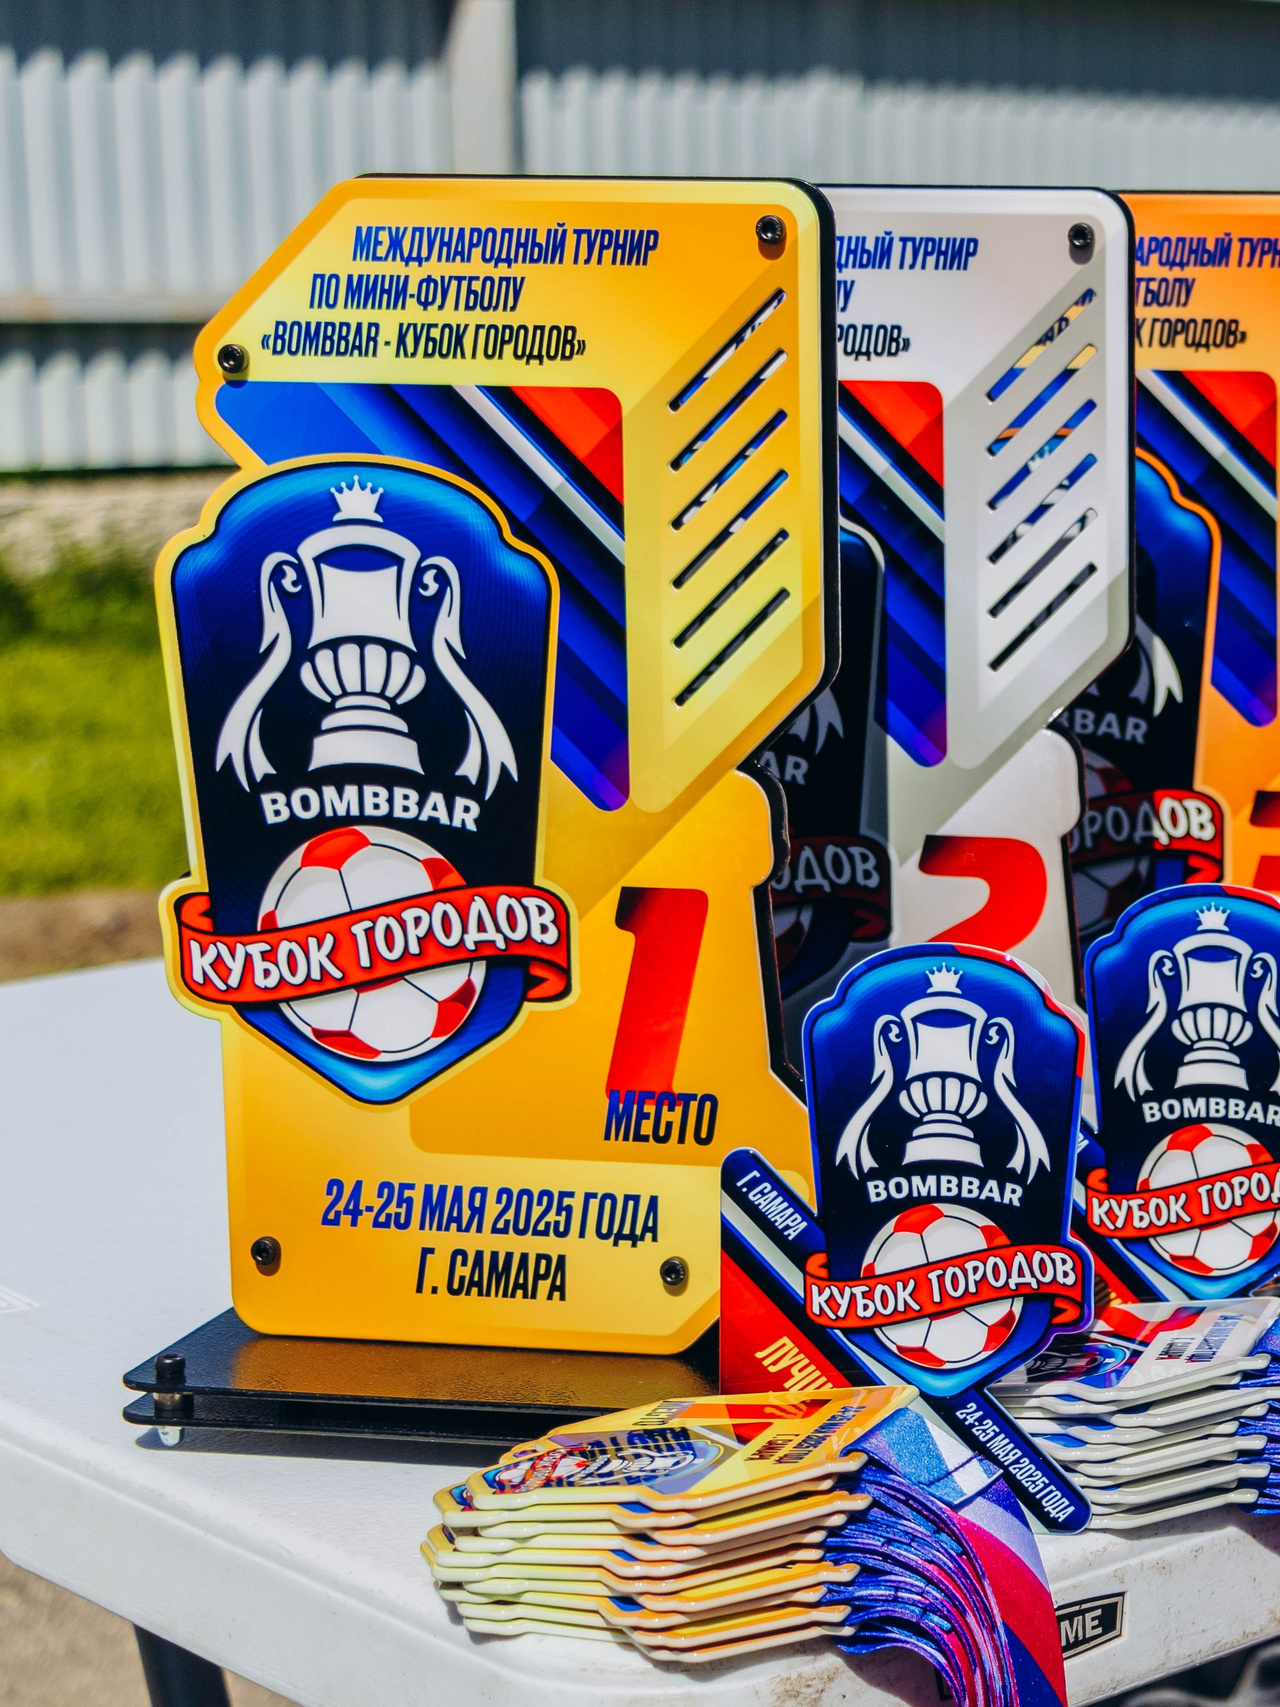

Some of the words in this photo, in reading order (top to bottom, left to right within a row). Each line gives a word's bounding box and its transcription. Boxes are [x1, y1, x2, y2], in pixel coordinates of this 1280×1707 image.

[352, 223, 567, 270] МЕЖДУНАРОДНЫЙ
[572, 228, 660, 267] ТУРНИР
[899, 236, 979, 271] ТУРНИР
[309, 273, 341, 310] ПО
[343, 273, 526, 312] МИНИ-ФУТБОЛУ
[394, 322, 471, 361] КУБОК
[470, 324, 587, 366] ГОРОДОВ»
[260, 785, 481, 832] BOMBBAR
[189, 931, 344, 991] КУБОК
[350, 894, 560, 969] ГОРОДОВ
[606, 886, 709, 1106] 1
[603, 1089, 720, 1147] МЕСТО
[321, 1178, 416, 1231] 24-25
[418, 1183, 488, 1234] МАЯ
[491, 1187, 576, 1239] 2025
[578, 1191, 660, 1248] ГОДА
[748, 1182, 808, 1240] САМАРА
[867, 1174, 1024, 1207] BOMBBAR
[1091, 1192, 1191, 1230] КУБОК
[416, 1247, 439, 1295] Г.
[447, 1248, 568, 1301] САМАРА
[811, 1278, 921, 1320] КУБОК
[927, 1251, 1077, 1303] ГОРОДОВ
[955, 1402, 1000, 1442] 24-25
[986, 1433, 1022, 1466] МАЯ
[1008, 1457, 1050, 1494] 2025
[1036, 1485, 1075, 1523] ГОДА
